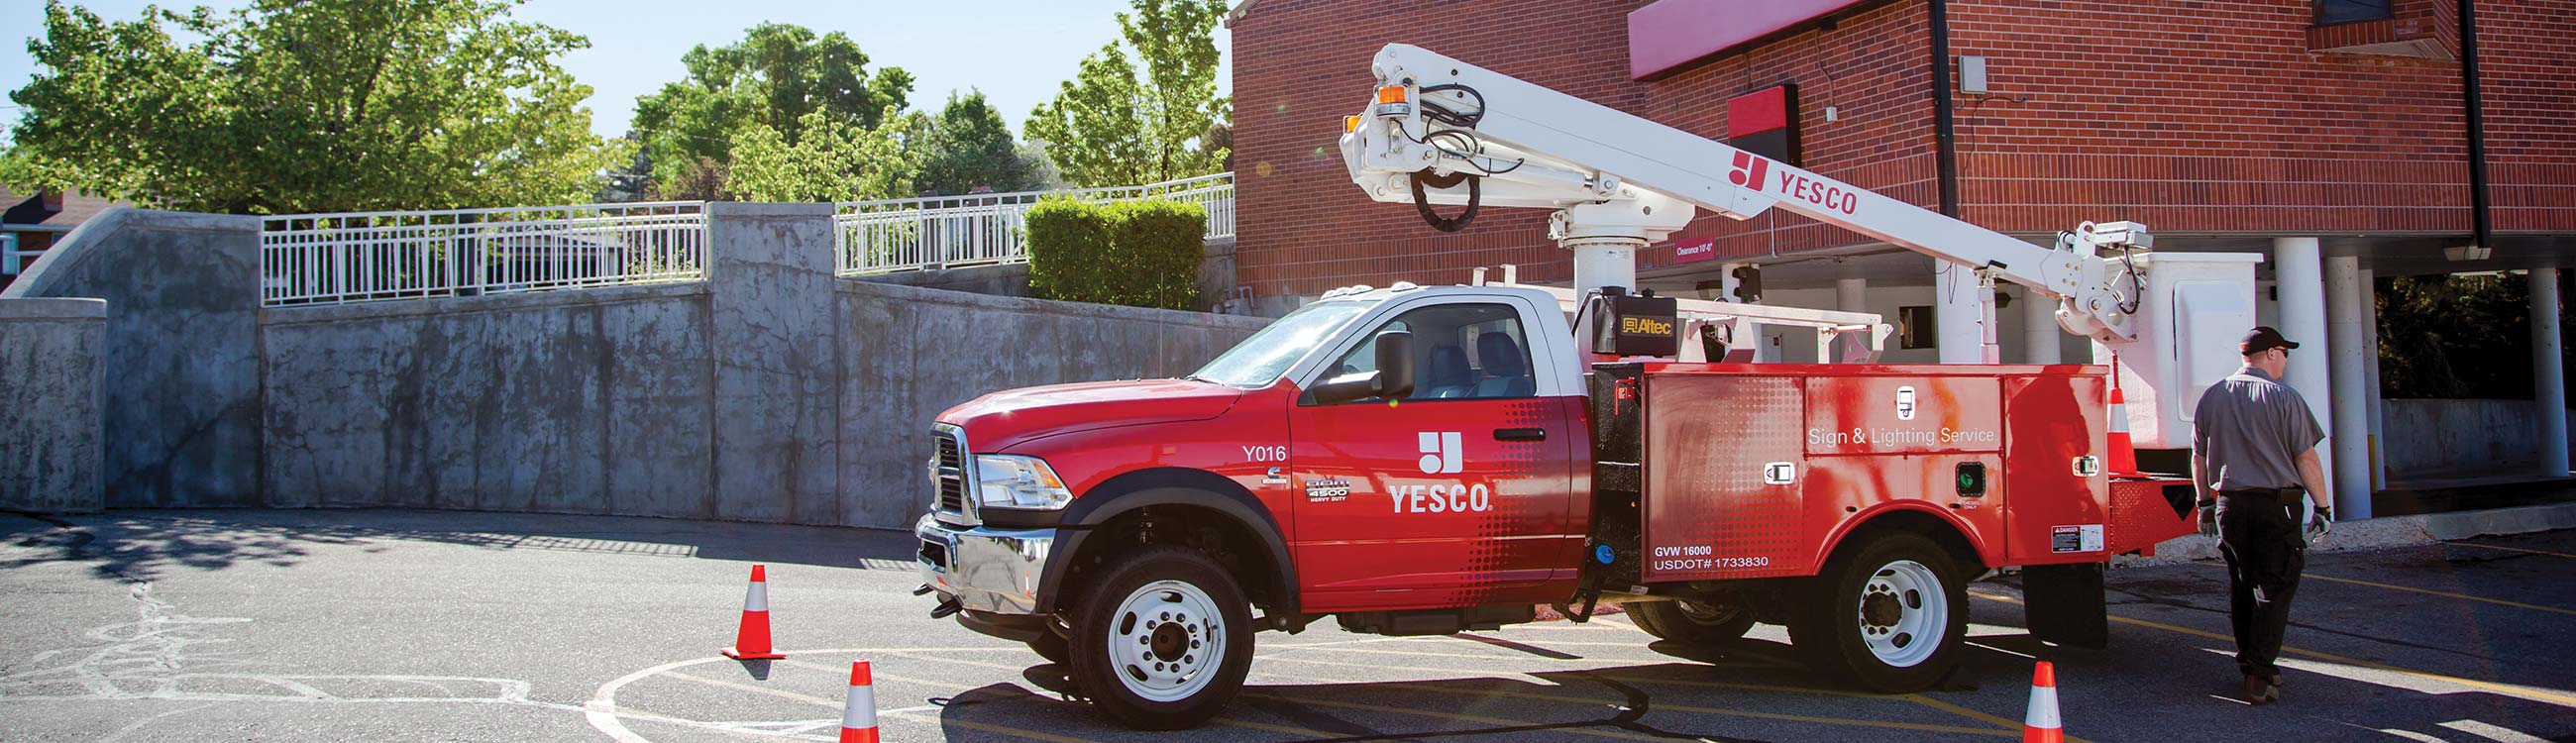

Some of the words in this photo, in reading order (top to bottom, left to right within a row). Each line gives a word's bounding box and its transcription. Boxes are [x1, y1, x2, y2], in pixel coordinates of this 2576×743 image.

[1780, 170, 1857, 215] YESCO
[1676, 247, 1699, 256] Clearance
[1638, 318, 1671, 335] Altec
[1808, 428, 1848, 448] Sign
[1852, 427, 1866, 444] &
[1872, 427, 1935, 446] Lighting
[1940, 427, 1994, 443] Service
[1242, 445, 1286, 462] Y016
[1388, 483, 1489, 513] YESCO
[1655, 546, 1680, 557] GVW
[1683, 545, 1712, 556] 16000
[1654, 559, 1712, 571] USDOT#
[1715, 556, 1769, 568] 1733830
